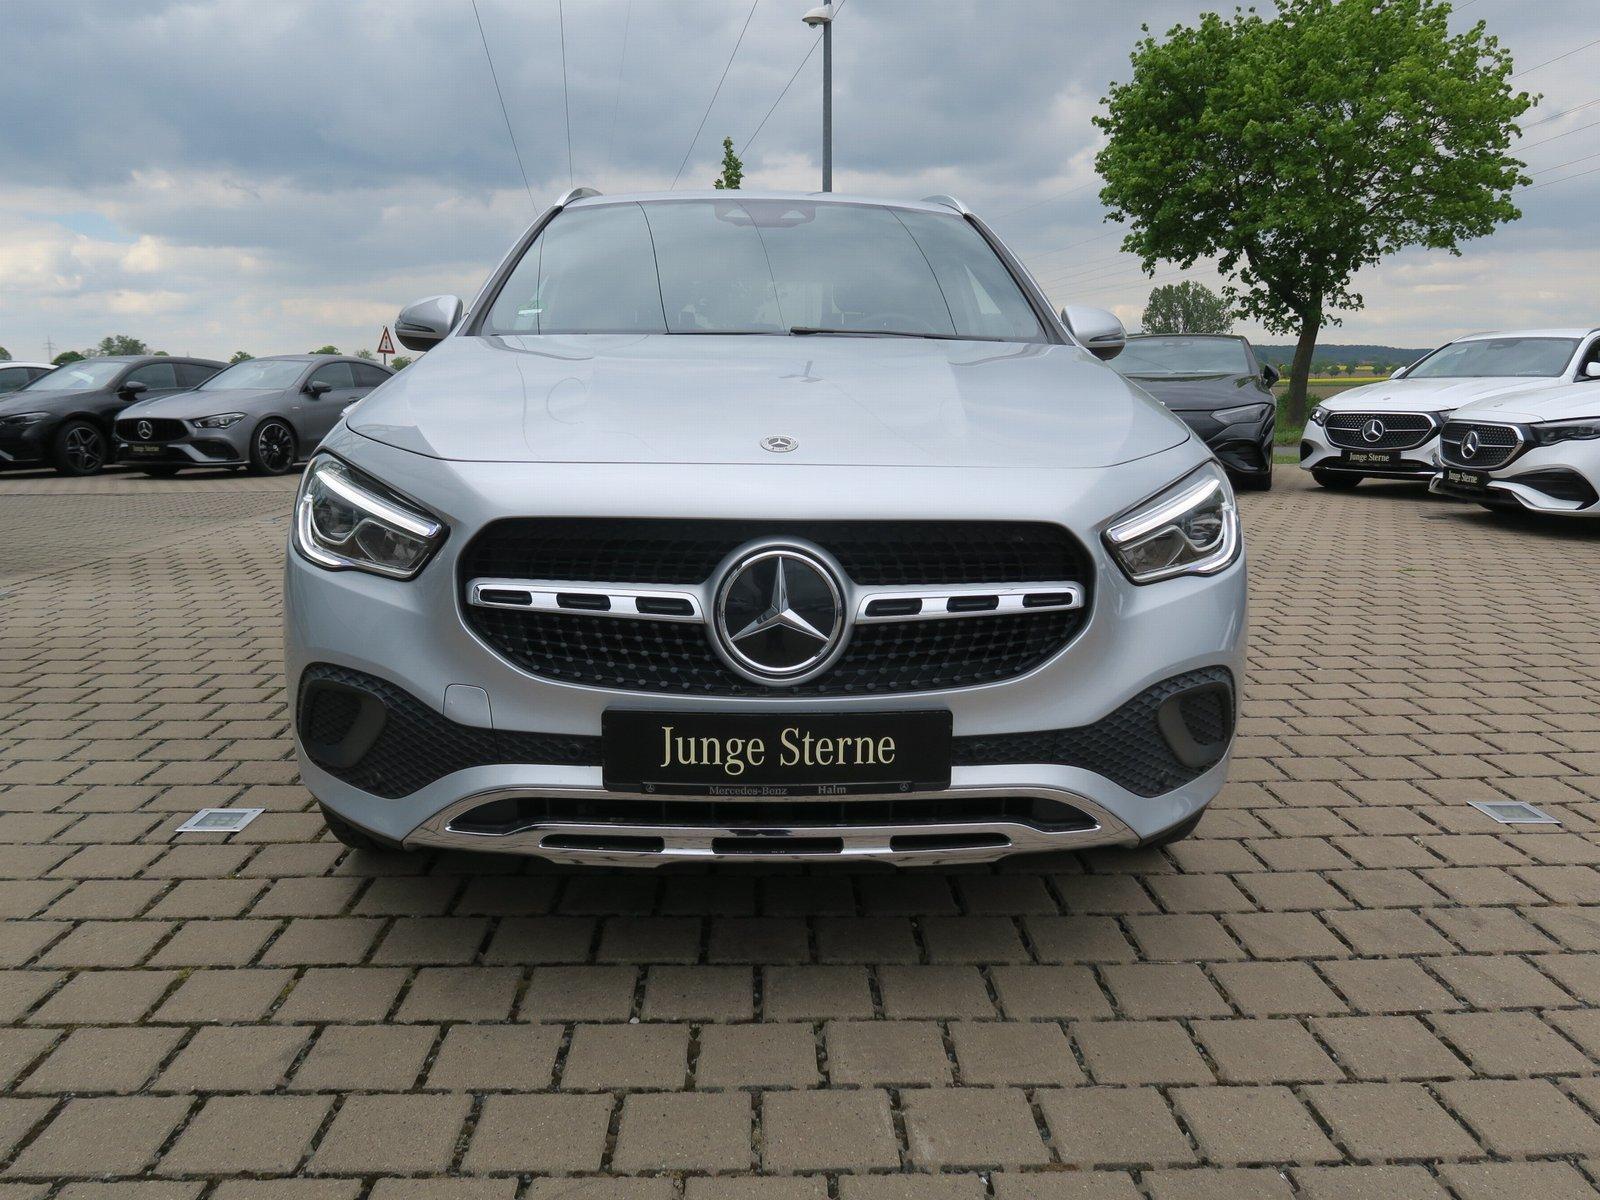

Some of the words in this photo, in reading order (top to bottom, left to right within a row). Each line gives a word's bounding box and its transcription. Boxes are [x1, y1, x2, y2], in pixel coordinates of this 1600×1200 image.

[660, 726, 765, 775] Junge
[780, 727, 896, 766] Sterne
[709, 786, 788, 796] Mercedes-Benz
